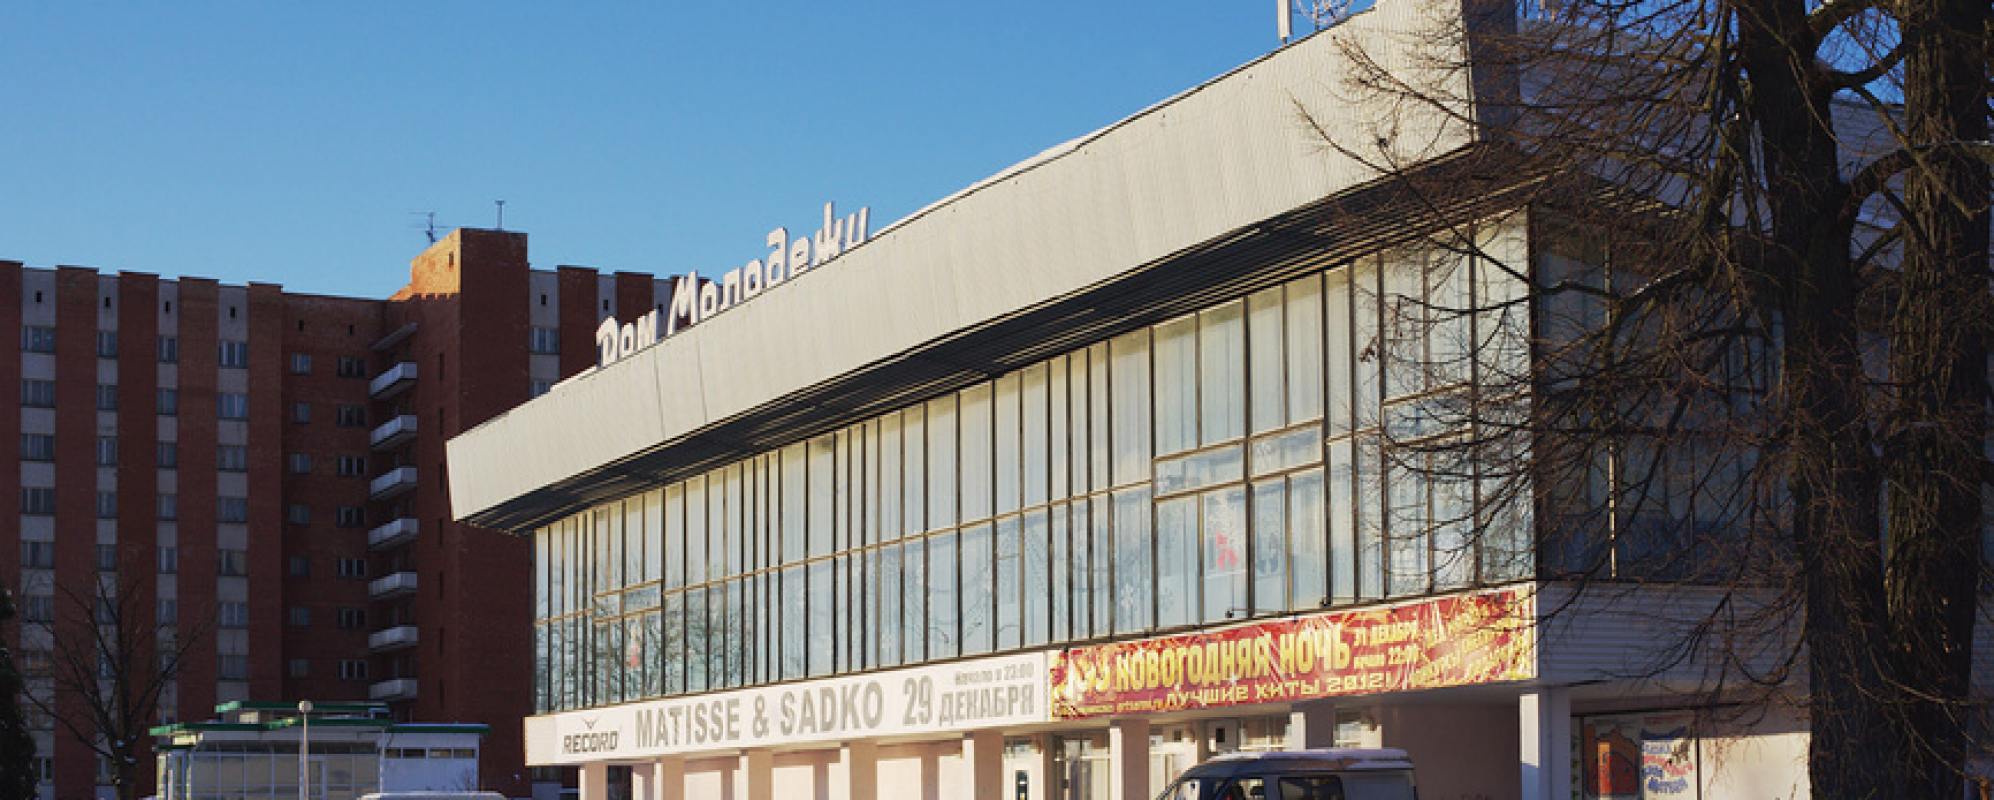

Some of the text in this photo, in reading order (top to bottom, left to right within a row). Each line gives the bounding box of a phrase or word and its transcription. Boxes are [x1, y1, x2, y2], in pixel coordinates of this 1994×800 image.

[1116, 631, 1272, 692] НОВОГОДНЯЯ
[1279, 622, 1350, 677] НОЧЬ
[635, 680, 884, 748] MATISSE & SADKO
[903, 675, 932, 726] 29
[939, 684, 1035, 727] ДЕКАБРЯ
[1167, 684, 1249, 707] ЛУЧШИЕ
[1255, 678, 1320, 700] ХИТЫ
[562, 731, 618, 755] RECORD
